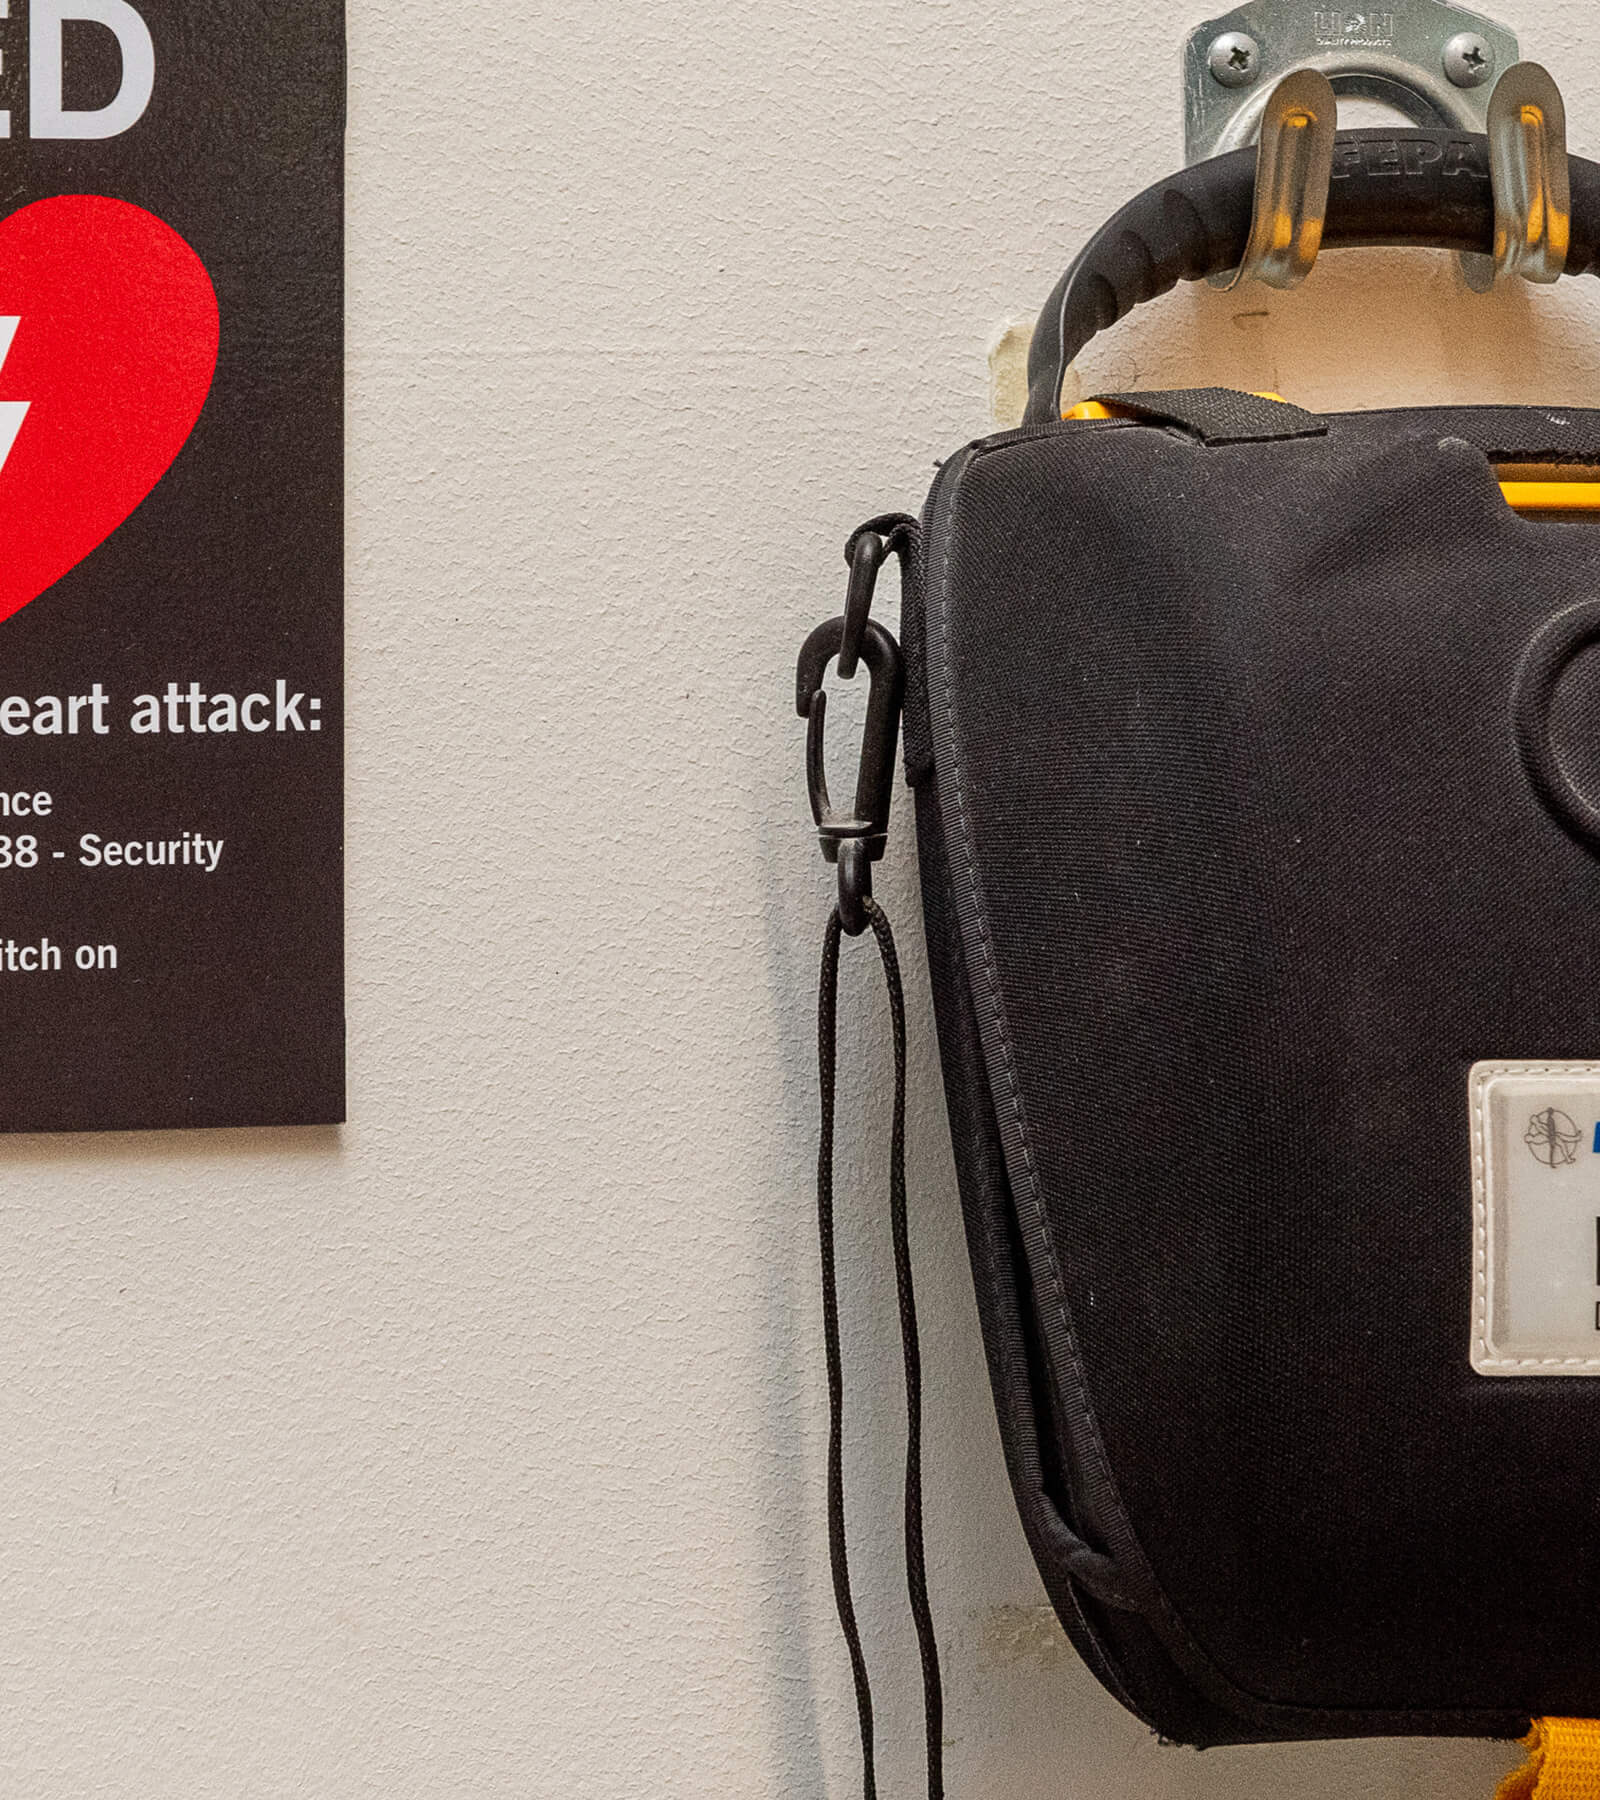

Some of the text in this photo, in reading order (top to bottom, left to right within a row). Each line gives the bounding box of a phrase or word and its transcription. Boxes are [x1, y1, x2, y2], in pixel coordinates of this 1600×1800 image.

[0, 0, 156, 140] D
[131, 680, 322, 735] attack:
[80, 832, 225, 873] Security
[76, 945, 118, 971] on
